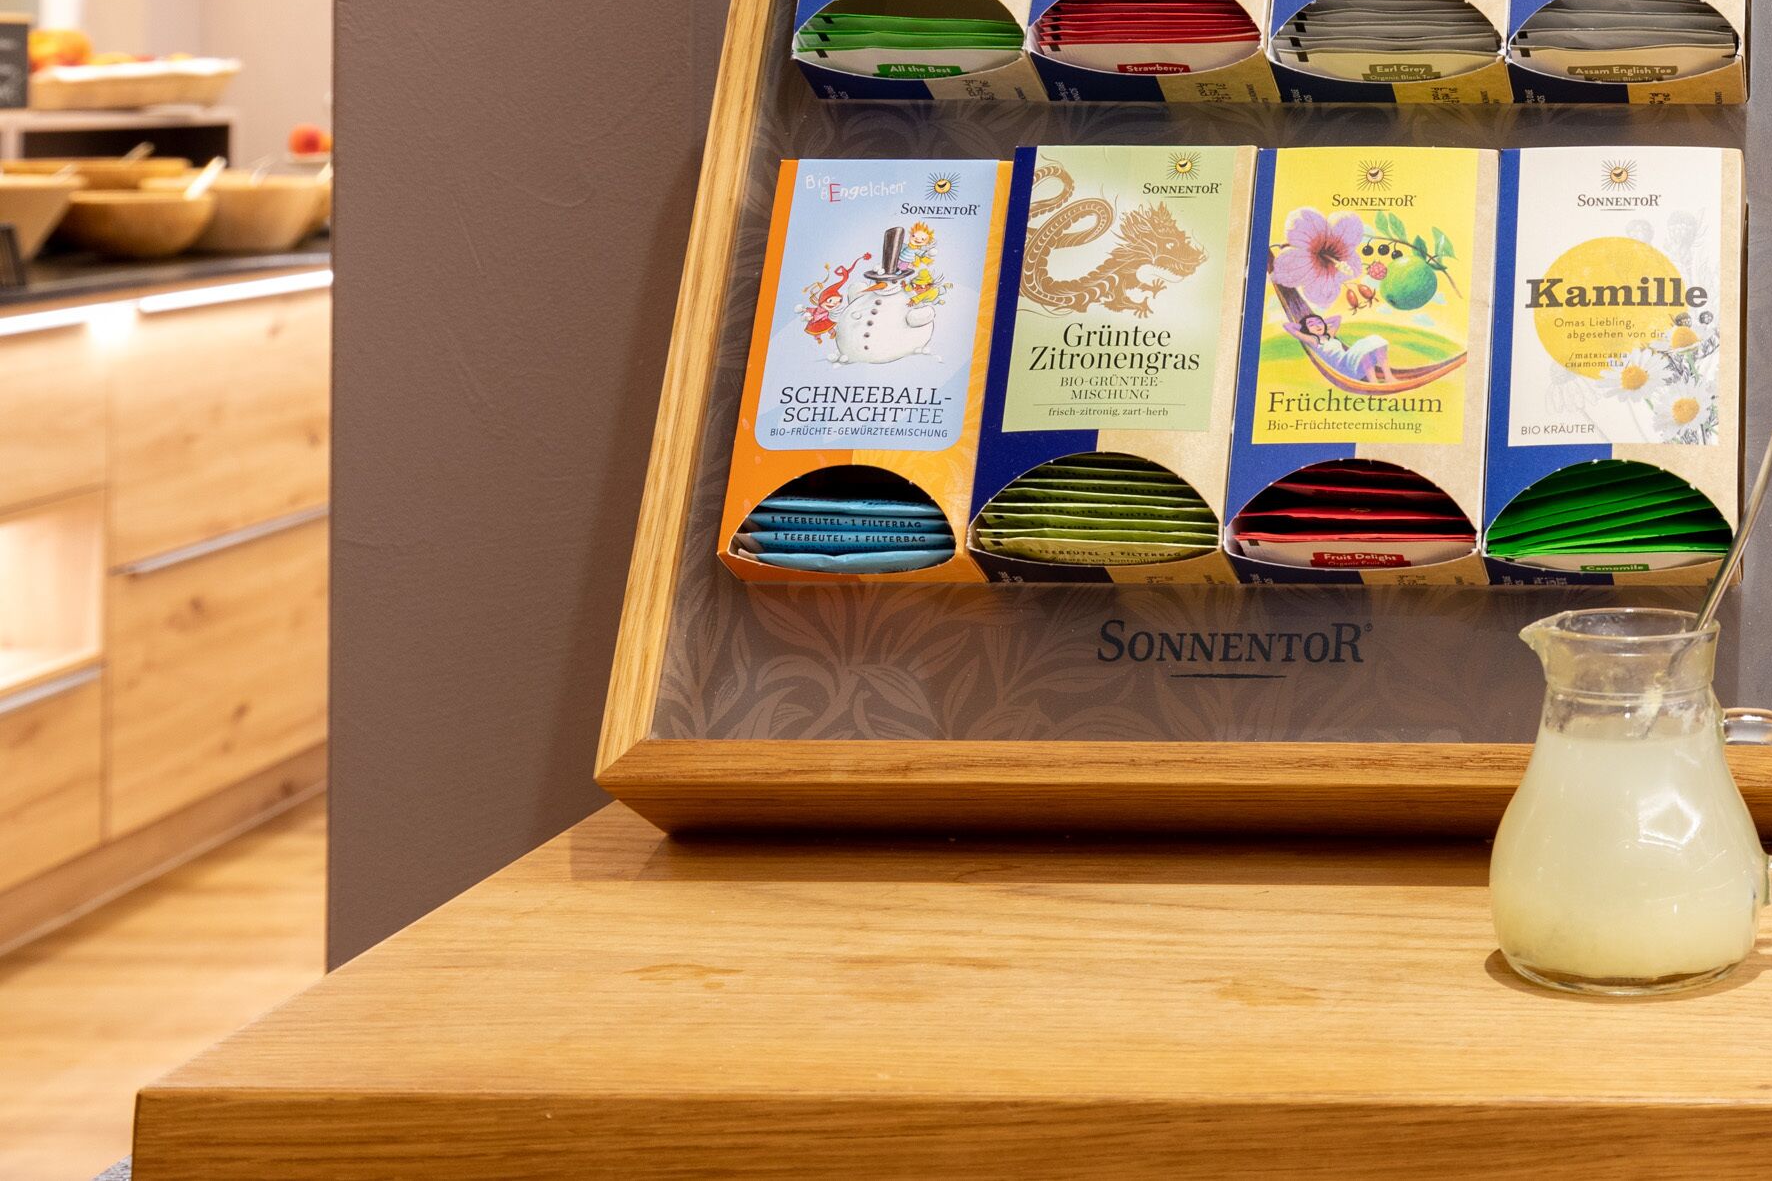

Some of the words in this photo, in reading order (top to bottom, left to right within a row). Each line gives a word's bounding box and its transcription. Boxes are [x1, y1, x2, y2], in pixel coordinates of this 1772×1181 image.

[890, 64, 905, 73] All
[908, 65, 925, 73] the
[928, 66, 951, 74] Best
[1126, 65, 1184, 73] Strawberry
[1400, 65, 1426, 75] Grey
[1575, 67, 1610, 75] Assam
[1613, 66, 1651, 77] English
[1525, 277, 1708, 309] Kamille
[1554, 318, 1585, 327] Omas
[1589, 317, 1635, 330] Liebling,
[1063, 322, 1171, 348] Grüntee
[1567, 329, 1624, 341] abgesehen
[1628, 331, 1646, 339] von
[1650, 329, 1668, 339] dir.
[1029, 346, 1200, 375] Zitronengras
[1060, 374, 1164, 387] BIO-GRÜNTEE-
[780, 386, 952, 405] SCHNEEBALL-
[1070, 389, 1149, 400] MISCHUNG
[1268, 390, 1443, 413] Früchtetraum
[783, 406, 943, 424] SCHLACHTTEE
[1048, 407, 1120, 417] frisch-zitronig,
[1122, 407, 1168, 416] zart-herb
[770, 426, 948, 438] BIO-FRÜCHTE-GEWÜRZTEEMISCHUNG
[1267, 419, 1422, 433] Bio-Früchteteemischung
[1521, 426, 1541, 435] BIO
[1544, 424, 1595, 434] KRÄUTER
[780, 516, 842, 526] TEEBEUTEL
[862, 519, 922, 528] FILTERBAG
[783, 533, 845, 543] TEEBEUTEL
[1354, 554, 1396, 562] Delight
